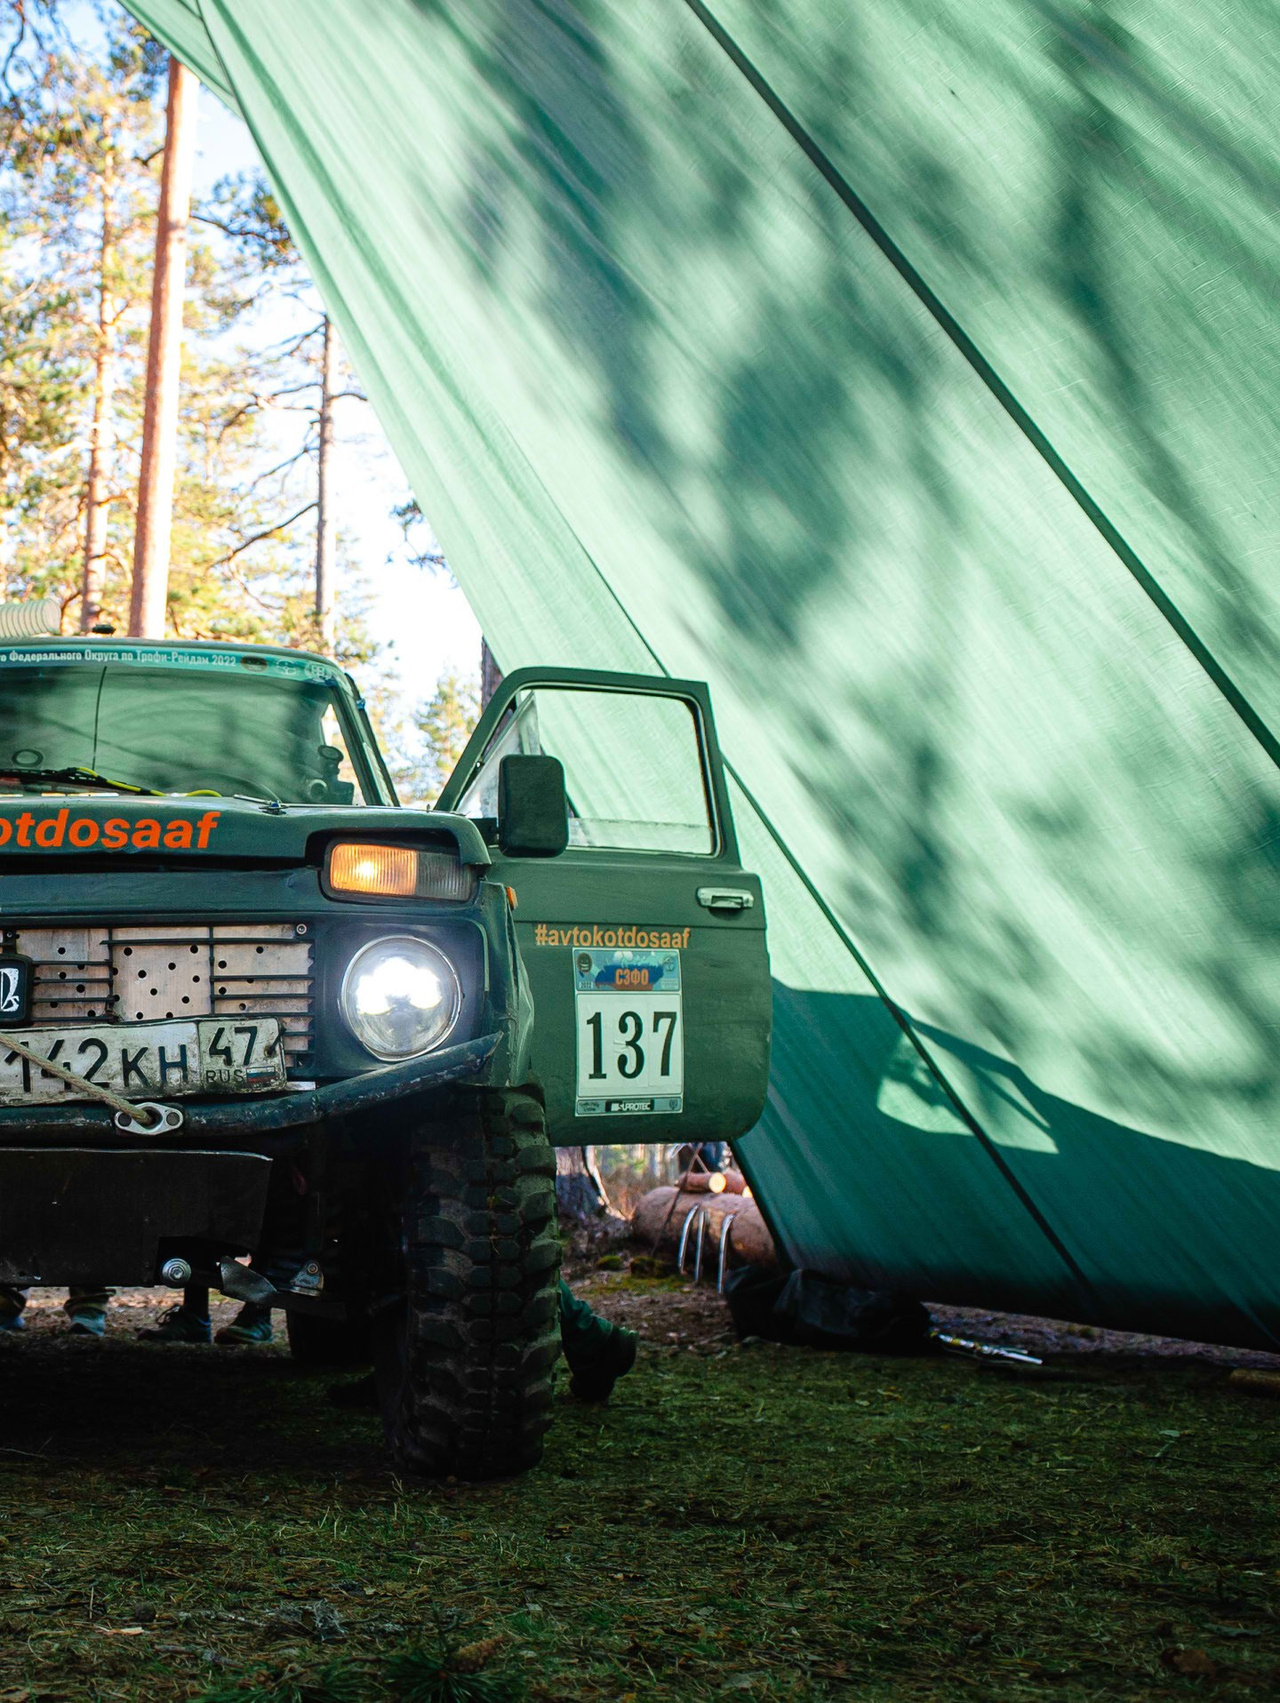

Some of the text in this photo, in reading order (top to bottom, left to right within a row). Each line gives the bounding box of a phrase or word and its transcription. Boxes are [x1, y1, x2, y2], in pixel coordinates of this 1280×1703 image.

[9, 649, 82, 663] Федерального
[84, 648, 119, 662] Округа
[121, 651, 133, 661] по
[135, 649, 209, 665] Трофи-Рейдам
[211, 654, 237, 667] 2022
[535, 923, 691, 949] #avtokotdosaaf
[615, 968, 649, 986] СЗФО
[207, 1026, 258, 1067] 47
[586, 1010, 678, 1080] 137
[205, 1068, 245, 1084] RUS
